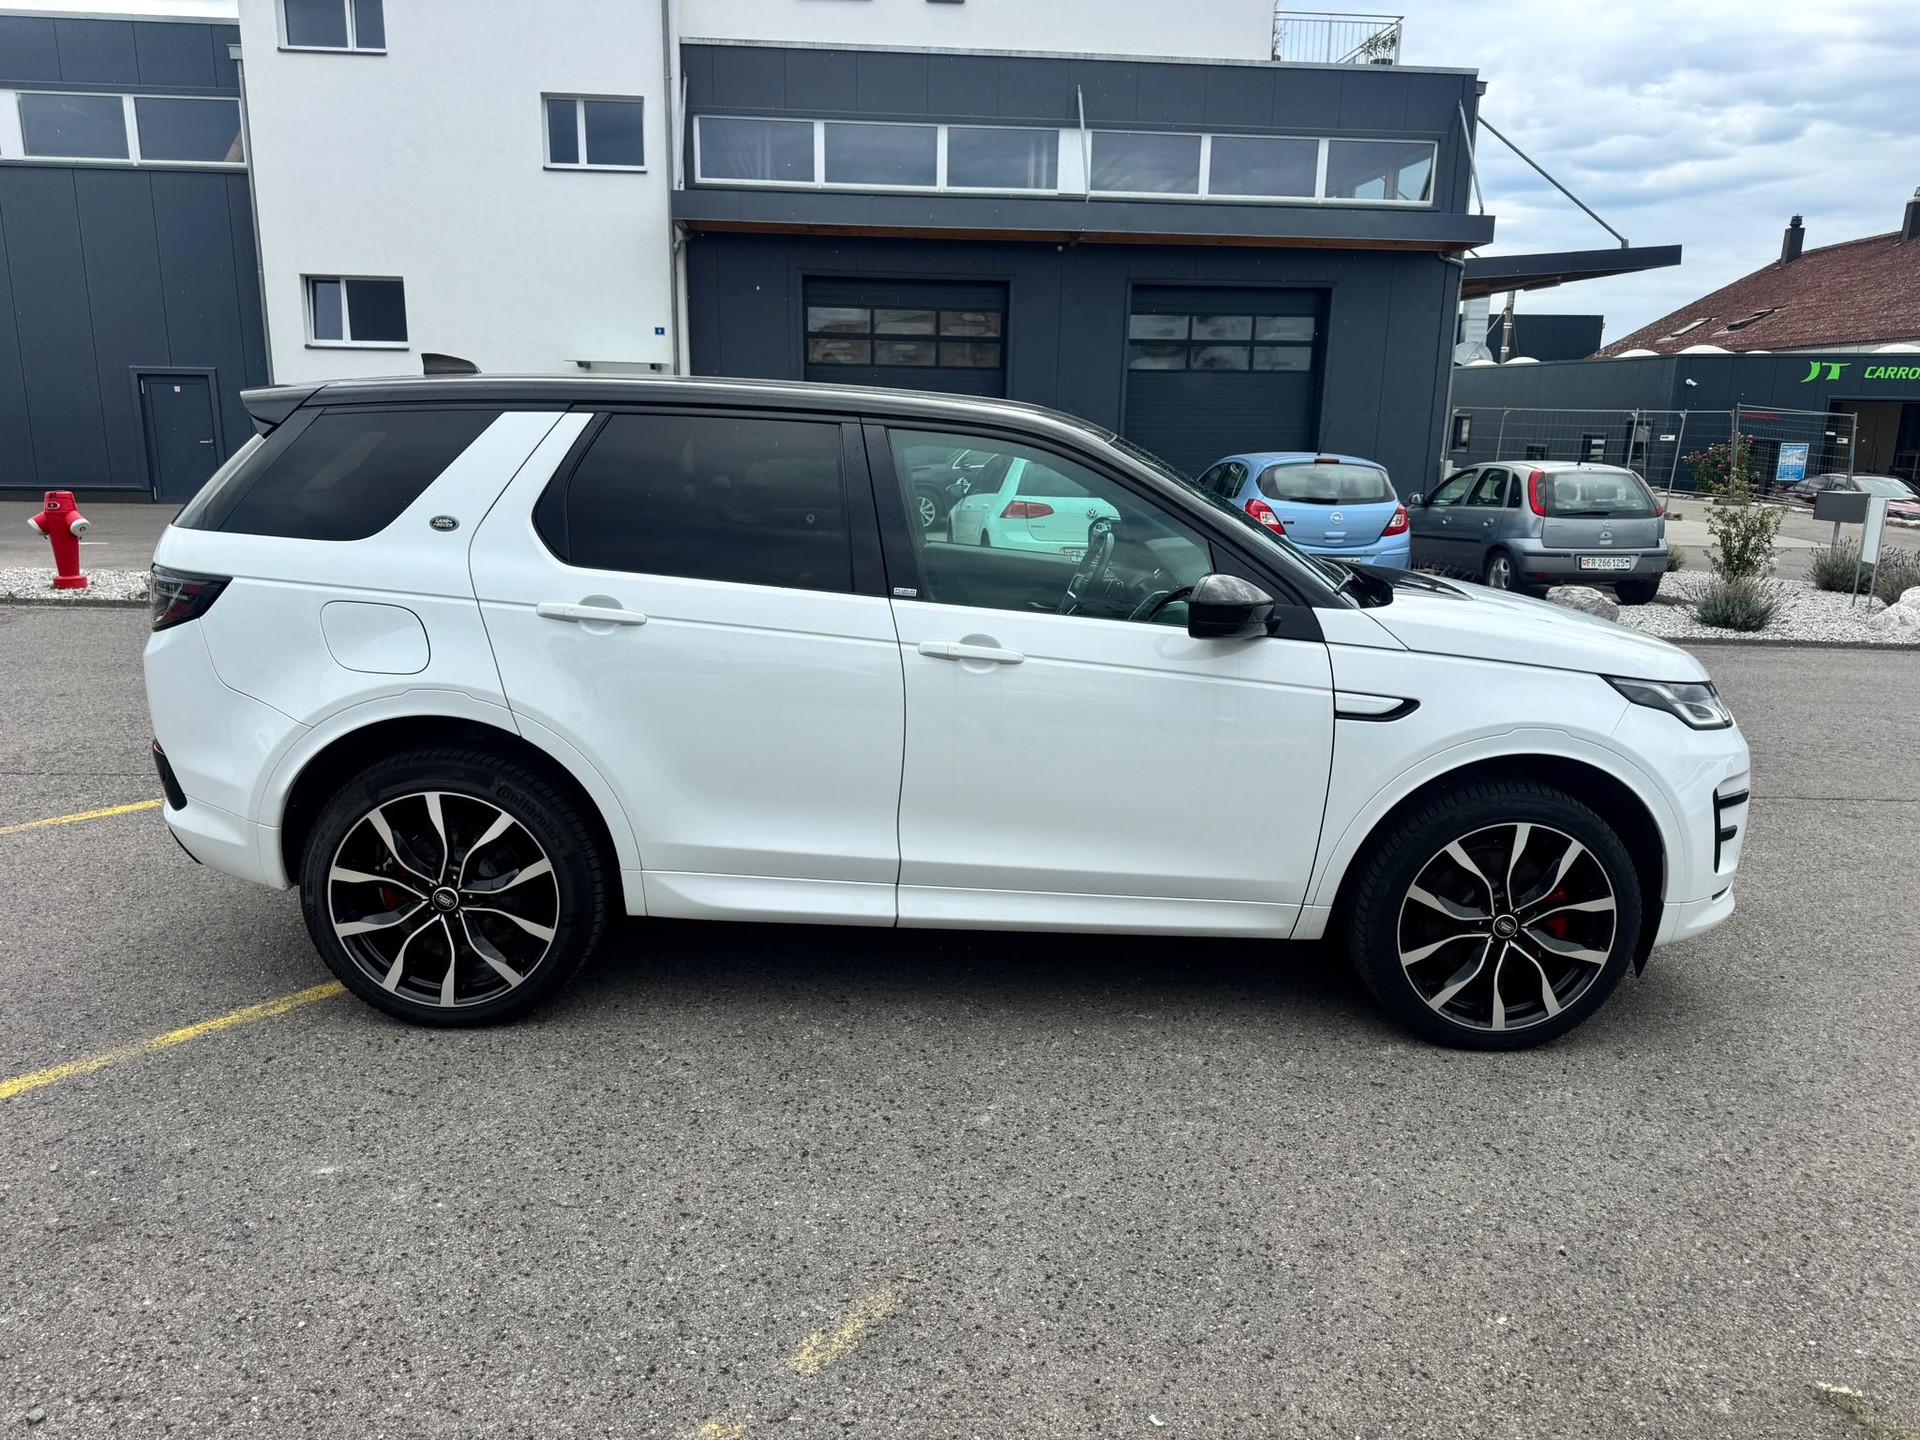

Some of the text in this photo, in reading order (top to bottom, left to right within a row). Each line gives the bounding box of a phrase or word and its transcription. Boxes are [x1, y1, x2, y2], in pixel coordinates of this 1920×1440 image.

[1800, 361, 1920, 383] JT CARRO
[1586, 558, 1596, 567] FR
[496, 785, 560, 841] Continental
